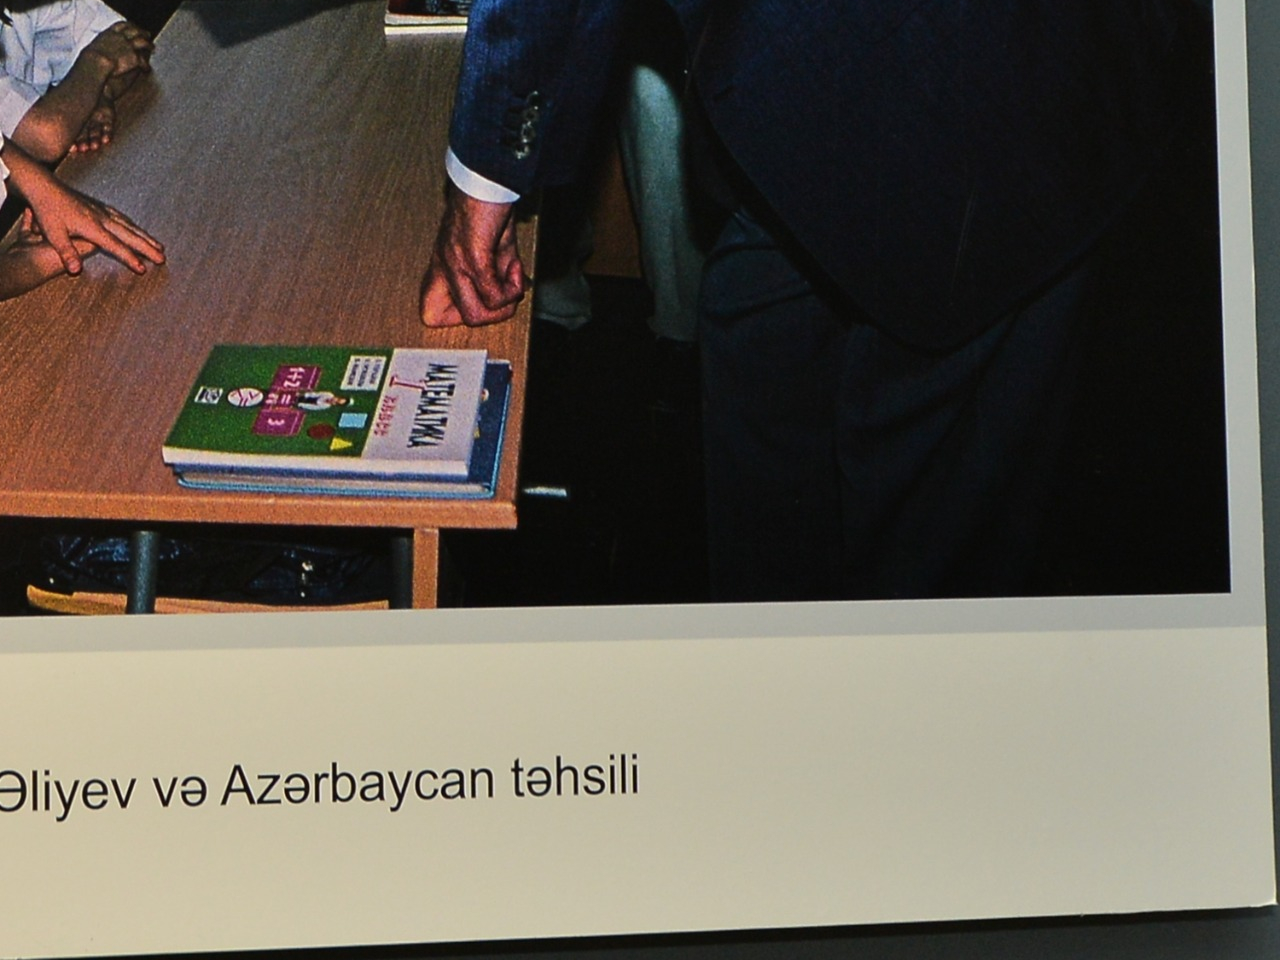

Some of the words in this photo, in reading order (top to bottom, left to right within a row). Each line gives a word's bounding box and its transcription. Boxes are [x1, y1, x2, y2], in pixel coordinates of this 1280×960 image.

[406, 362, 458, 448] МАТЕМАТИКА
[152, 776, 207, 808] və
[220, 761, 494, 813] Azərbaycan
[510, 753, 638, 797] təhsili
